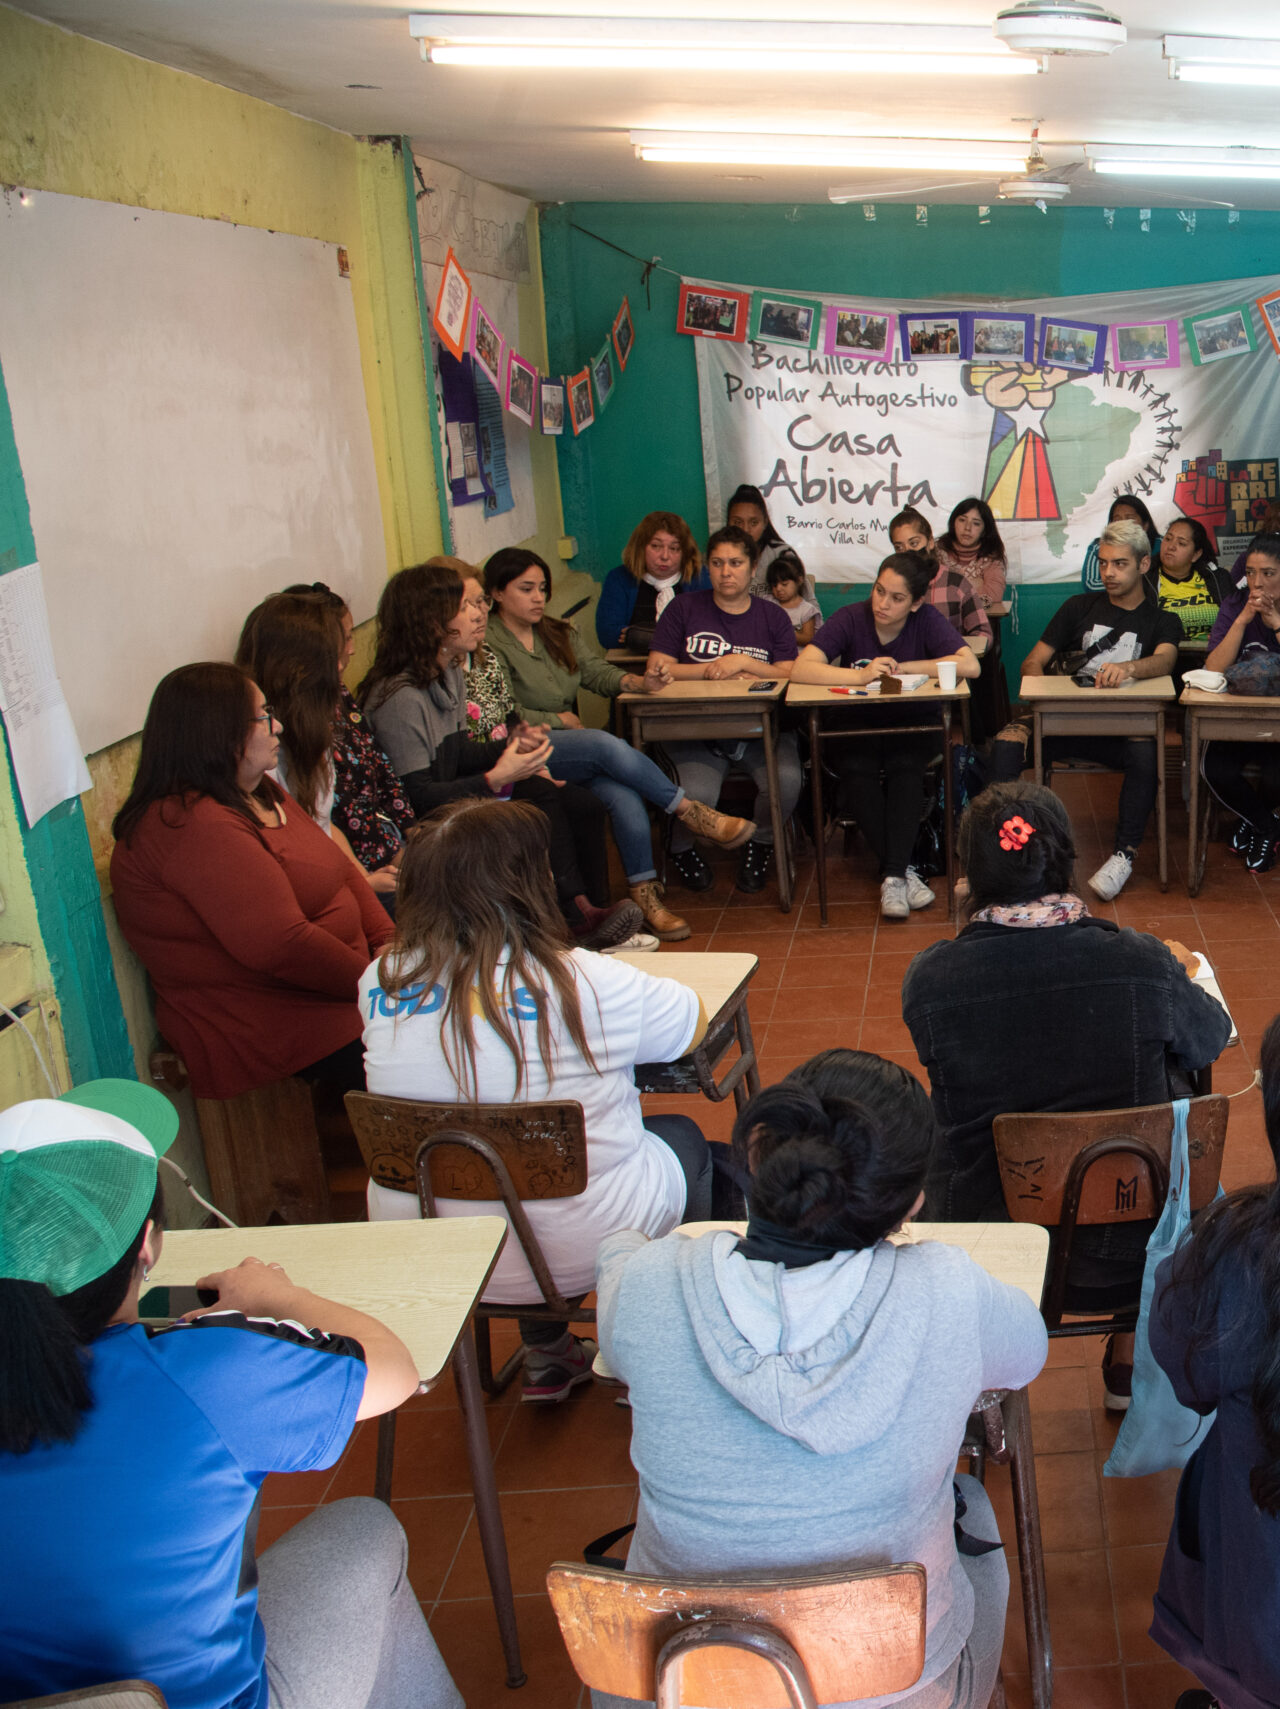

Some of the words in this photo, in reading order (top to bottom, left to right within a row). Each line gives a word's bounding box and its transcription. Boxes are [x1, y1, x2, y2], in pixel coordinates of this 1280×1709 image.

[749, 338, 919, 378] Bachillerato
[723, 372, 810, 409] Popular
[818, 381, 958, 417] Autogestivo
[786, 414, 903, 457] Casa
[757, 455, 938, 508] Abierta
[786, 515, 823, 530] Barrio
[826, 516, 867, 531] Carlos
[829, 532, 855, 546] Villa
[857, 533, 869, 545] 31
[685, 636, 732, 656] UTEP
